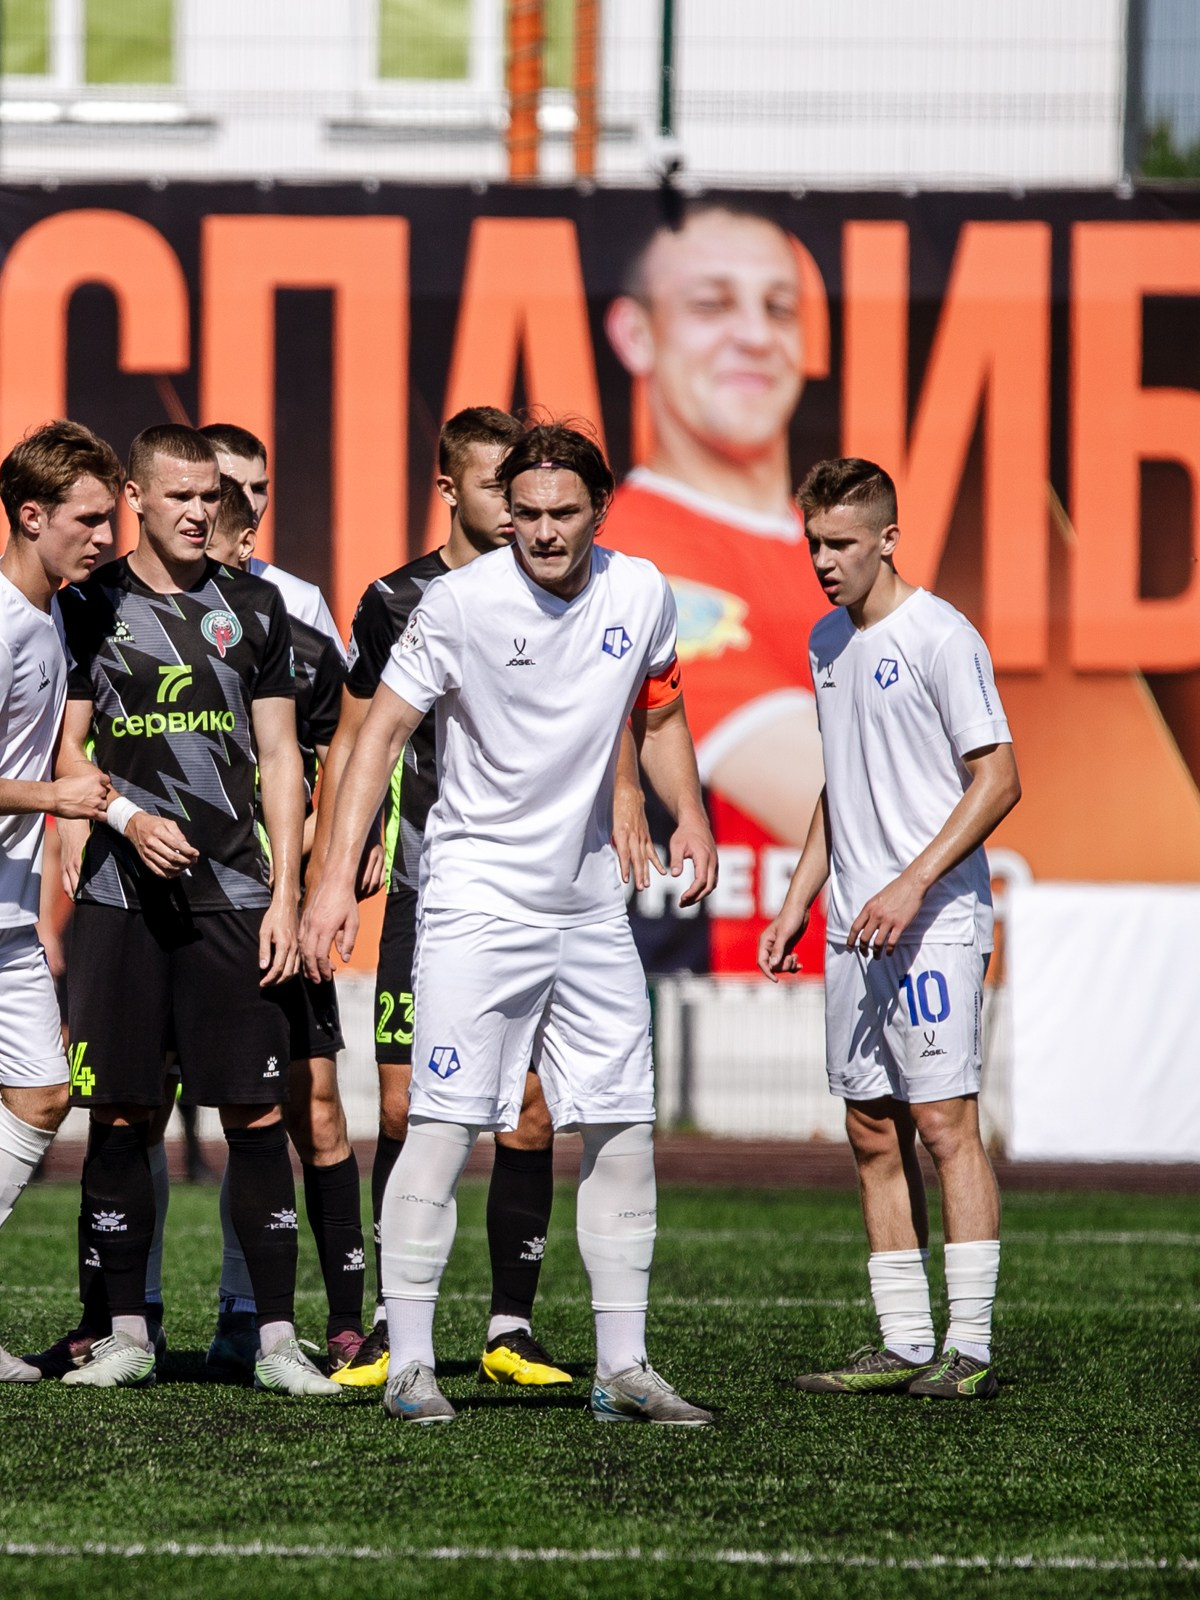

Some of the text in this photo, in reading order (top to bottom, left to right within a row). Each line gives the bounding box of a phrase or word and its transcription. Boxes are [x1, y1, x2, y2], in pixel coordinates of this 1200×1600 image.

[505, 658, 536, 667] JÖGEL
[111, 710, 236, 738] сервико
[899, 969, 951, 1027] 10
[376, 990, 415, 1045] 23
[919, 1049, 948, 1058] JÖGEL
